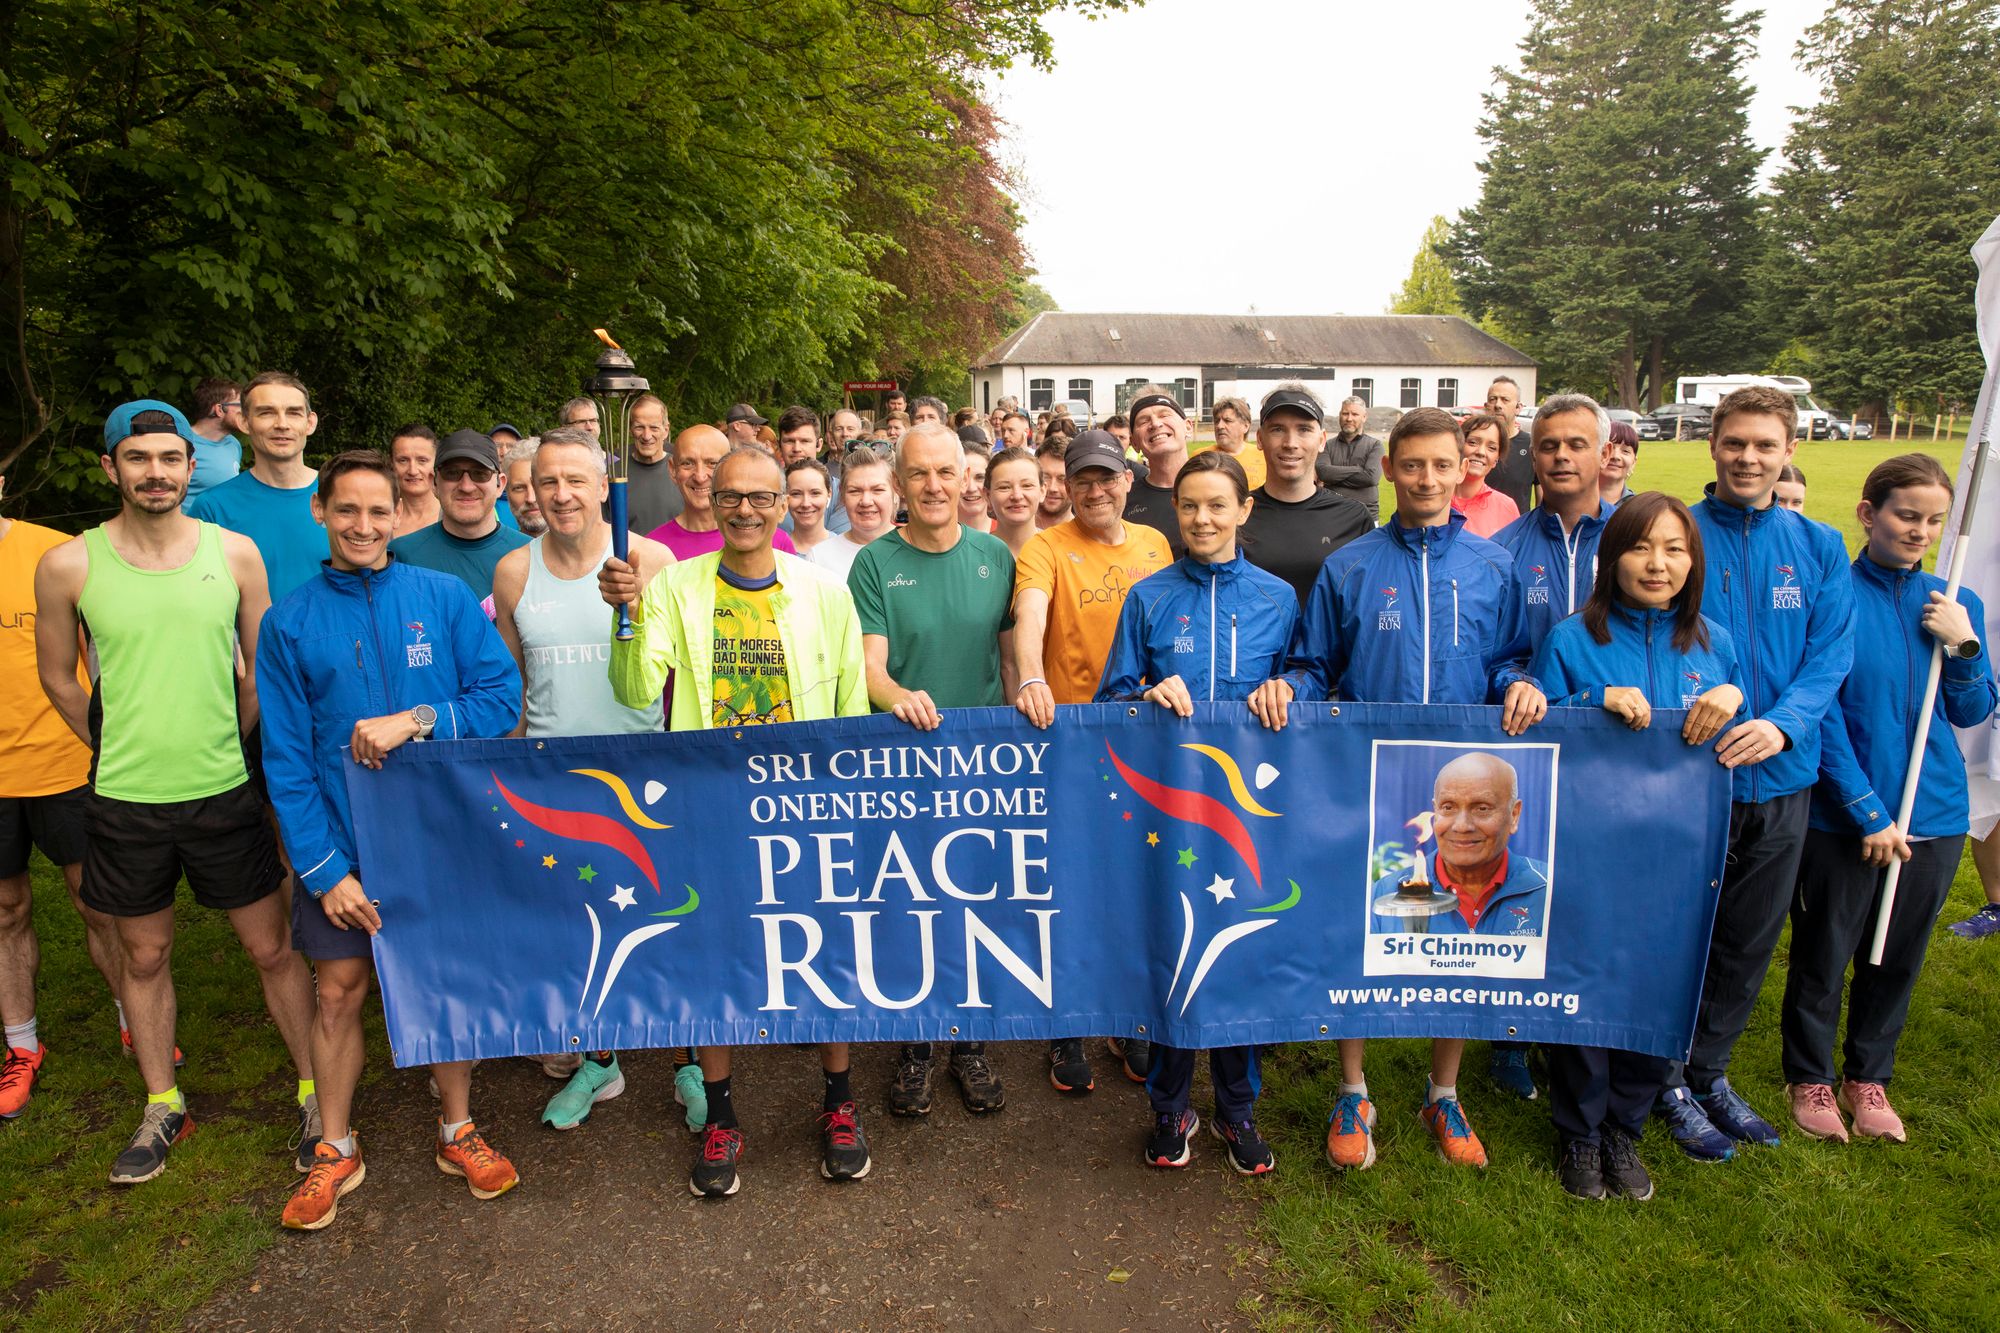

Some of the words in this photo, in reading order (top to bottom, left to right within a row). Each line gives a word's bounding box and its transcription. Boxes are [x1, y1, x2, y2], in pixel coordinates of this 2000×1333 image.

[888, 574, 916, 588] parkrun
[1773, 600, 1801, 609] RUN
[1379, 622, 1401, 630] RUN
[408, 655, 433, 667] RUN
[738, 666, 757, 675] NEW
[760, 666, 788, 676] GUINE
[748, 753, 815, 784] SRI
[829, 743, 1050, 780] CHINMOY
[750, 788, 1048, 823] ONENESS-HOME
[749, 828, 1053, 905] PEACE
[750, 907, 1061, 1011] RUN
[1383, 937, 1414, 955] Sri
[1420, 938, 1527, 962] Chinmoy
[1430, 959, 1477, 968] Founder
[1328, 987, 1580, 1014] www.peacerun.org
